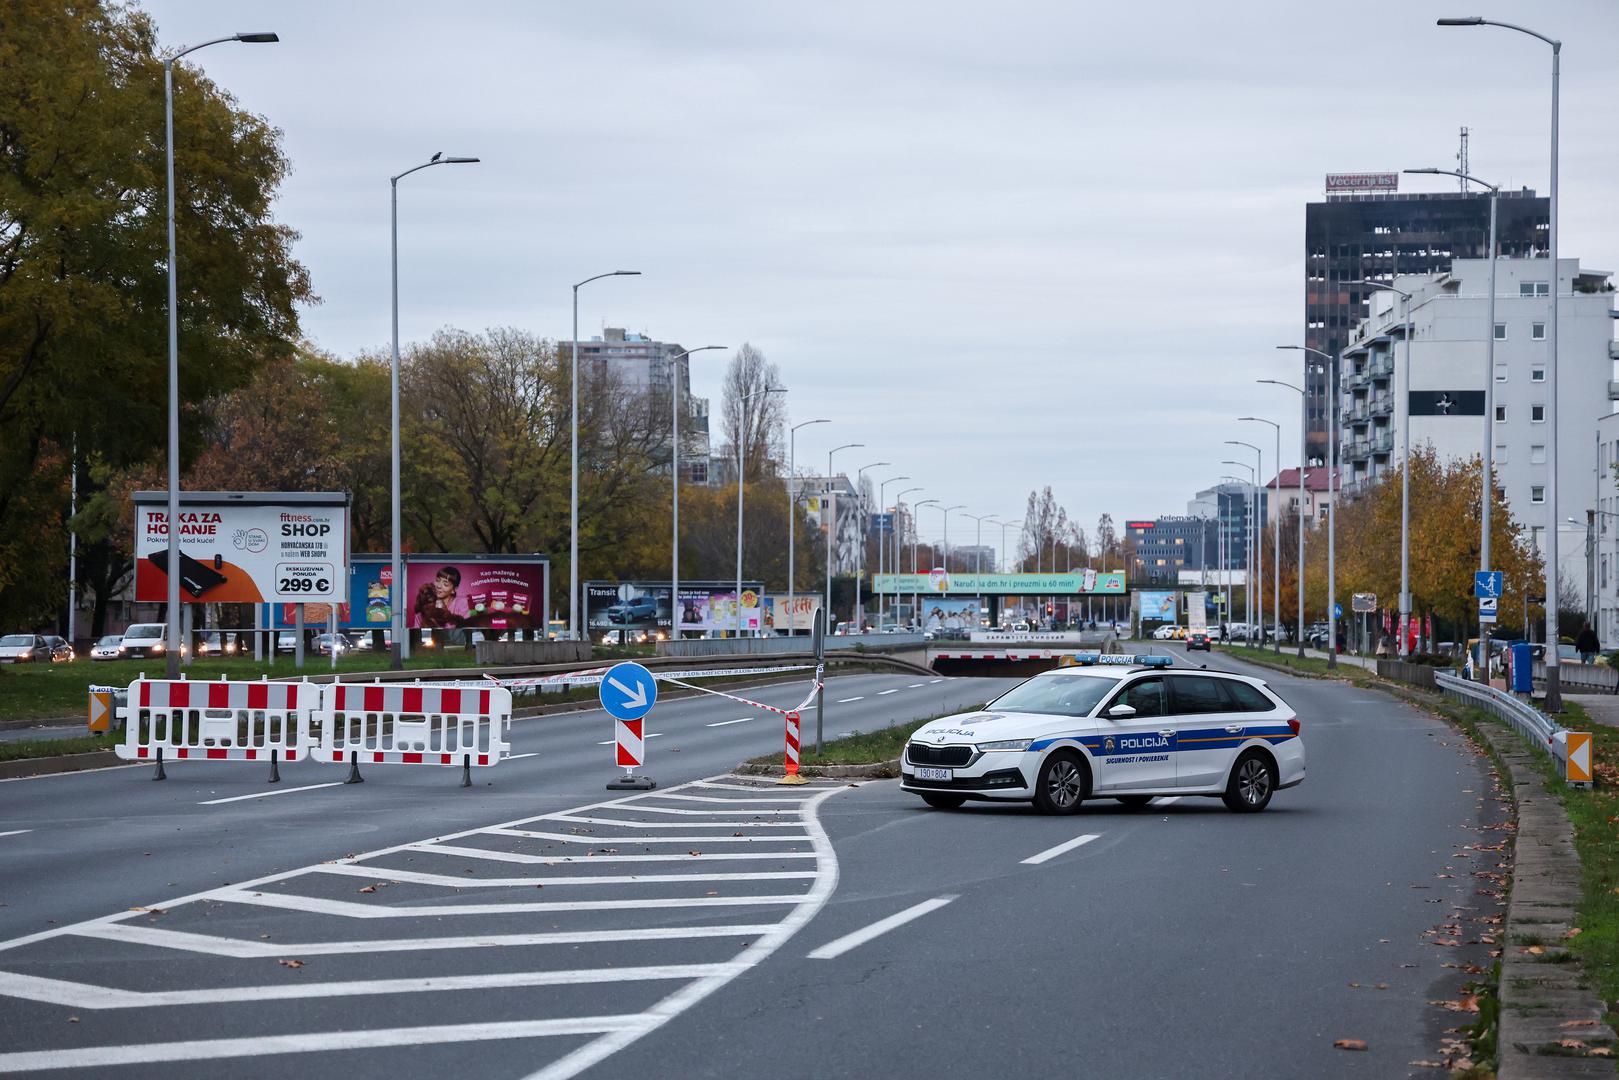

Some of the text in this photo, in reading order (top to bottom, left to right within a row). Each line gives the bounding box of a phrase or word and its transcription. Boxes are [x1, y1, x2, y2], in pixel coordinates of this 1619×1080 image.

[1378, 175, 1395, 185] list
[201, 513, 222, 523] ZA
[147, 524, 216, 535] HOANJE
[281, 523, 330, 536] SHOP
[280, 578, 330, 592] 299 €
[500, 577, 529, 587] ljubimcem
[954, 579, 975, 587] Naruči
[1013, 580, 1041, 589] preuzmi
[589, 588, 616, 596] Transit
[1101, 655, 1132, 663] POLICIJA
[924, 728, 975, 737] POLICIJA
[1120, 737, 1169, 749] POLICIJA
[1105, 756, 1135, 765] SIGURNOST
[1139, 754, 1169, 763] POVJERENJE
[920, 768, 947, 779] 190 804
